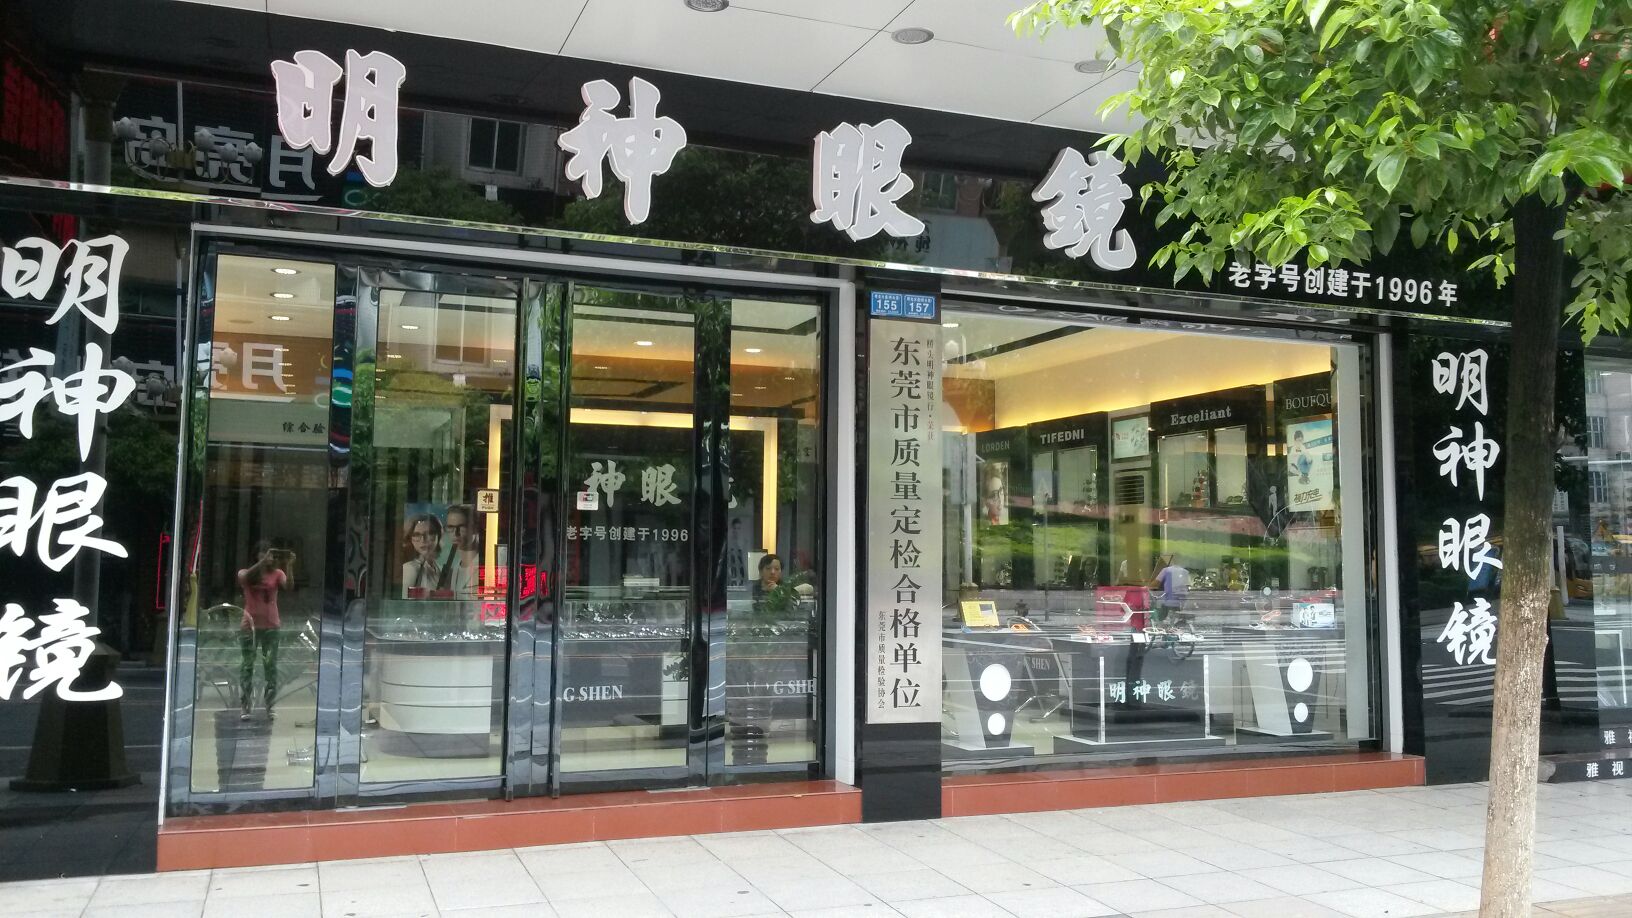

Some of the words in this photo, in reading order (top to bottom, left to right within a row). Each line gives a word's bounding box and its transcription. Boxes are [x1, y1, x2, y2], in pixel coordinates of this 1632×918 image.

[1228, 261, 1458, 307] 老字号创建于1996年
[877, 299, 897, 311] 155
[909, 302, 929, 313] 157
[1170, 405, 1232, 426] Exceliant
[1040, 428, 1085, 444] TIFEDNI
[483, 492, 493, 504] 推
[889, 337, 922, 709] 东莞市质量定检合格单位
[566, 526, 689, 542] 老字号创建于1996
[878, 610, 886, 709] 东莞市质量检验协会
[579, 685, 623, 701] SHEN
[1586, 761, 1624, 777] 雅视
